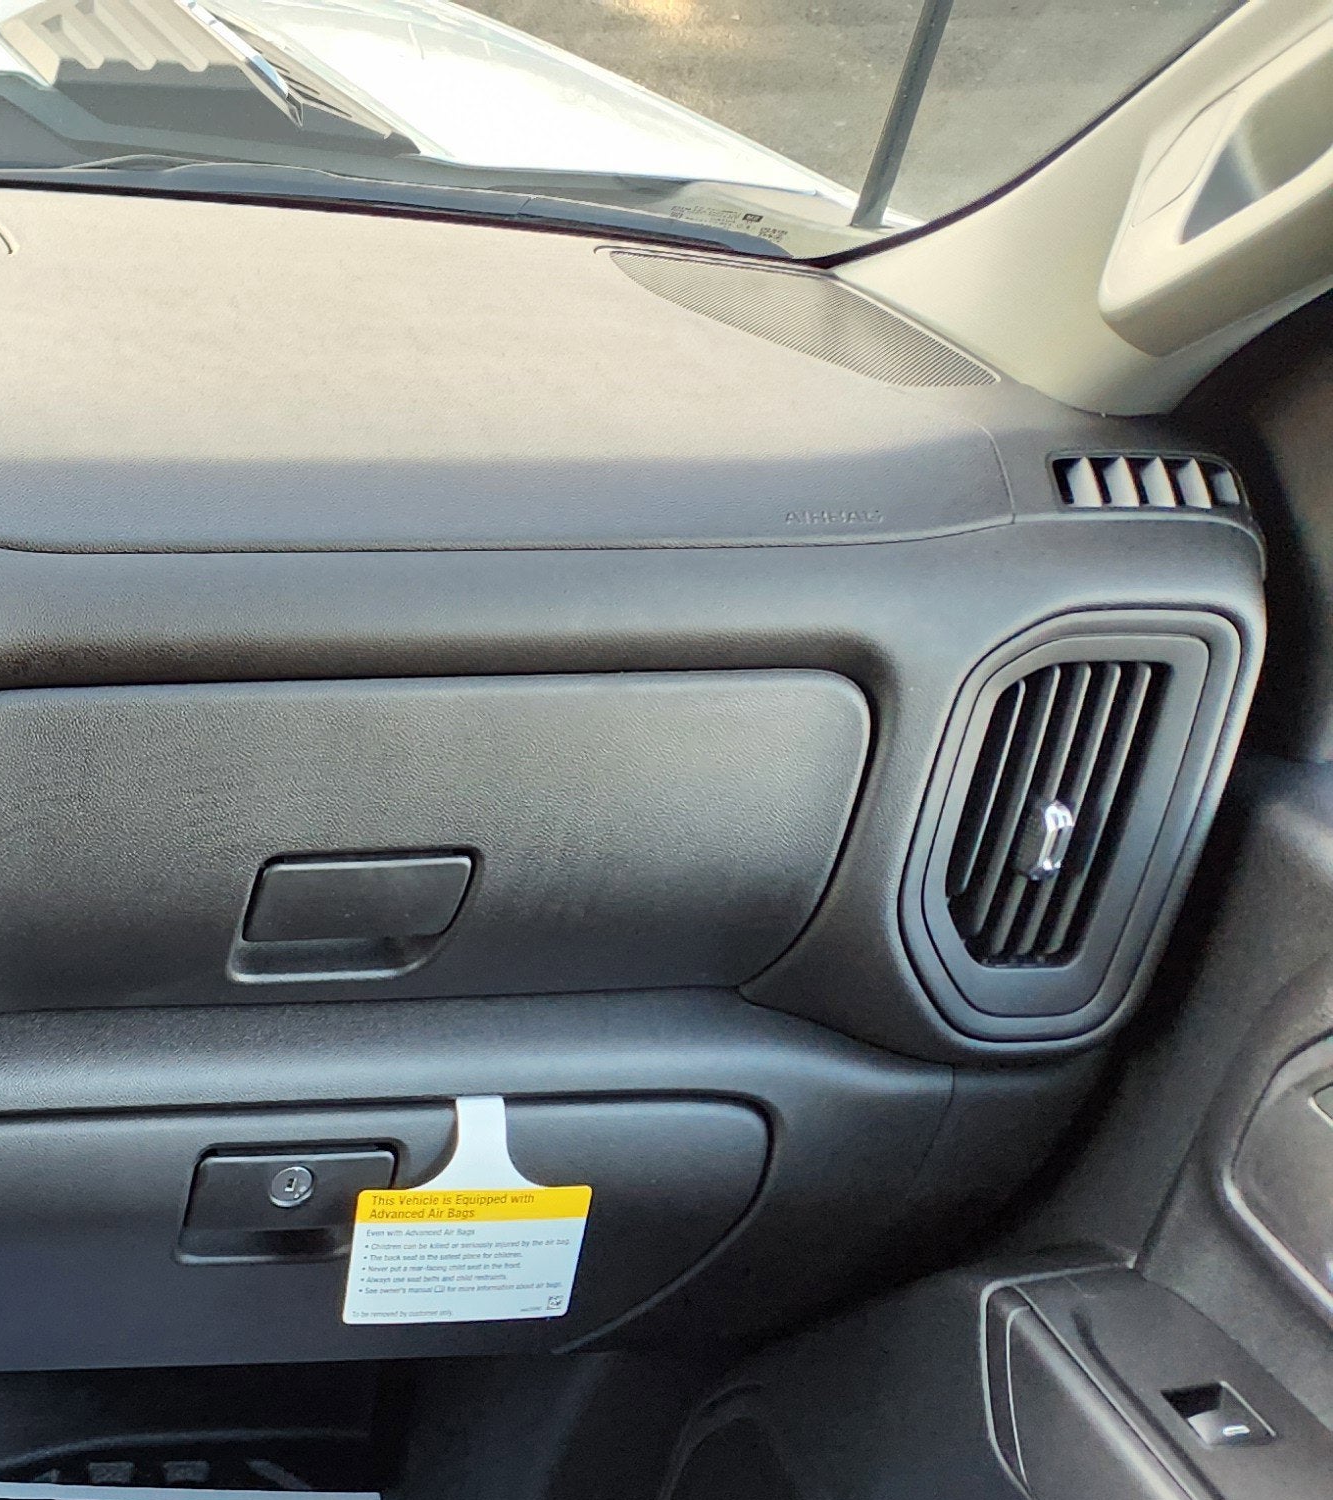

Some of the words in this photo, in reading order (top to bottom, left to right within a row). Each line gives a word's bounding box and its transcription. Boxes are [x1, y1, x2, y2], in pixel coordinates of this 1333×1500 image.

[371, 1195, 395, 1206] This
[399, 1194, 439, 1205] Vehicle
[443, 1194, 452, 1205] is
[455, 1193, 507, 1206] Equipped
[510, 1192, 535, 1203] with
[369, 1208, 425, 1219] Advanced
[427, 1207, 444, 1218] Air
[447, 1207, 475, 1220] Bags
[366, 1229, 385, 1237] Even
[387, 1228, 403, 1237] with
[405, 1228, 443, 1237] Advanced
[444, 1228, 454, 1236] Air
[456, 1228, 475, 1238] Bags
